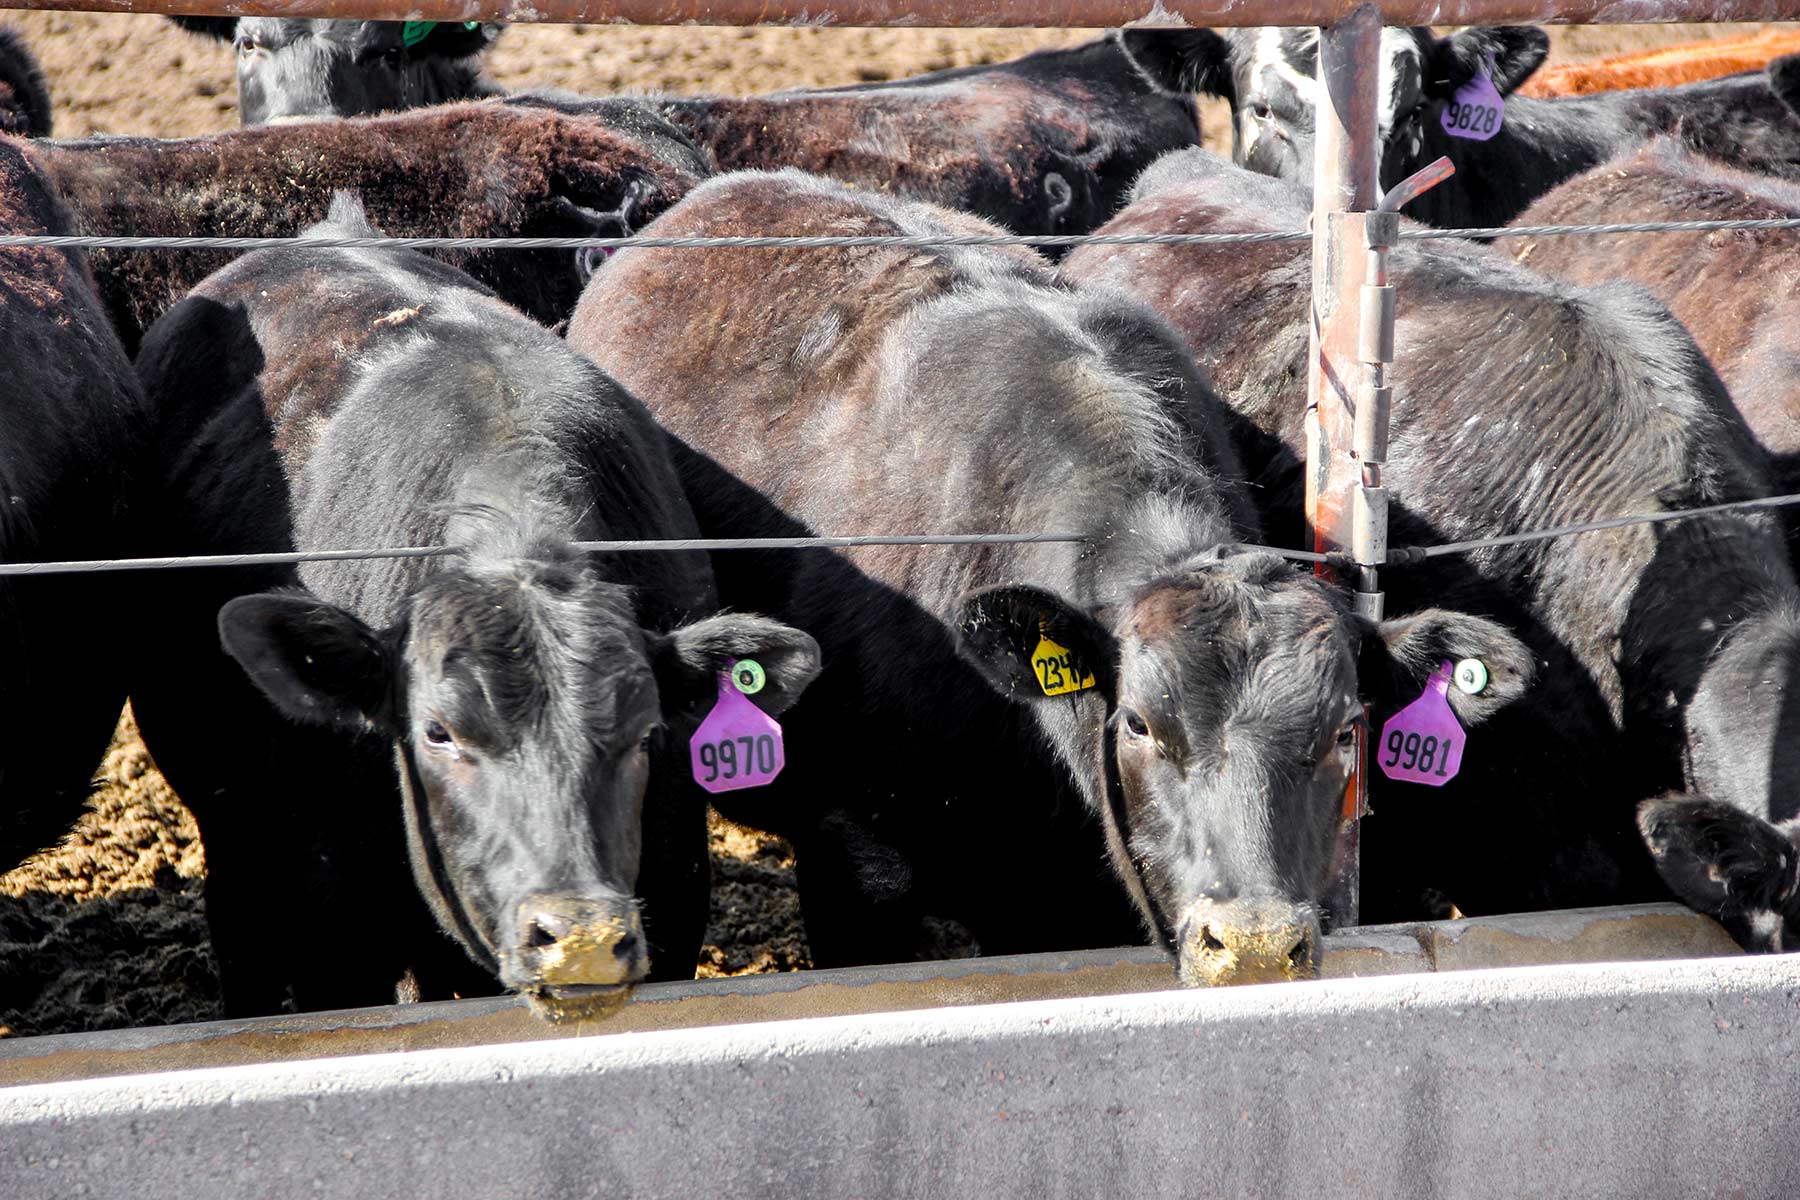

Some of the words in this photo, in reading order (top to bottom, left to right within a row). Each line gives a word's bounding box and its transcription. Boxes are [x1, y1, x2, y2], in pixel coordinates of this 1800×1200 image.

[1446, 102, 1498, 134] 9828
[1036, 653, 1088, 689] 234
[700, 734, 775, 782] 9970
[1385, 730, 1452, 777] 9981
